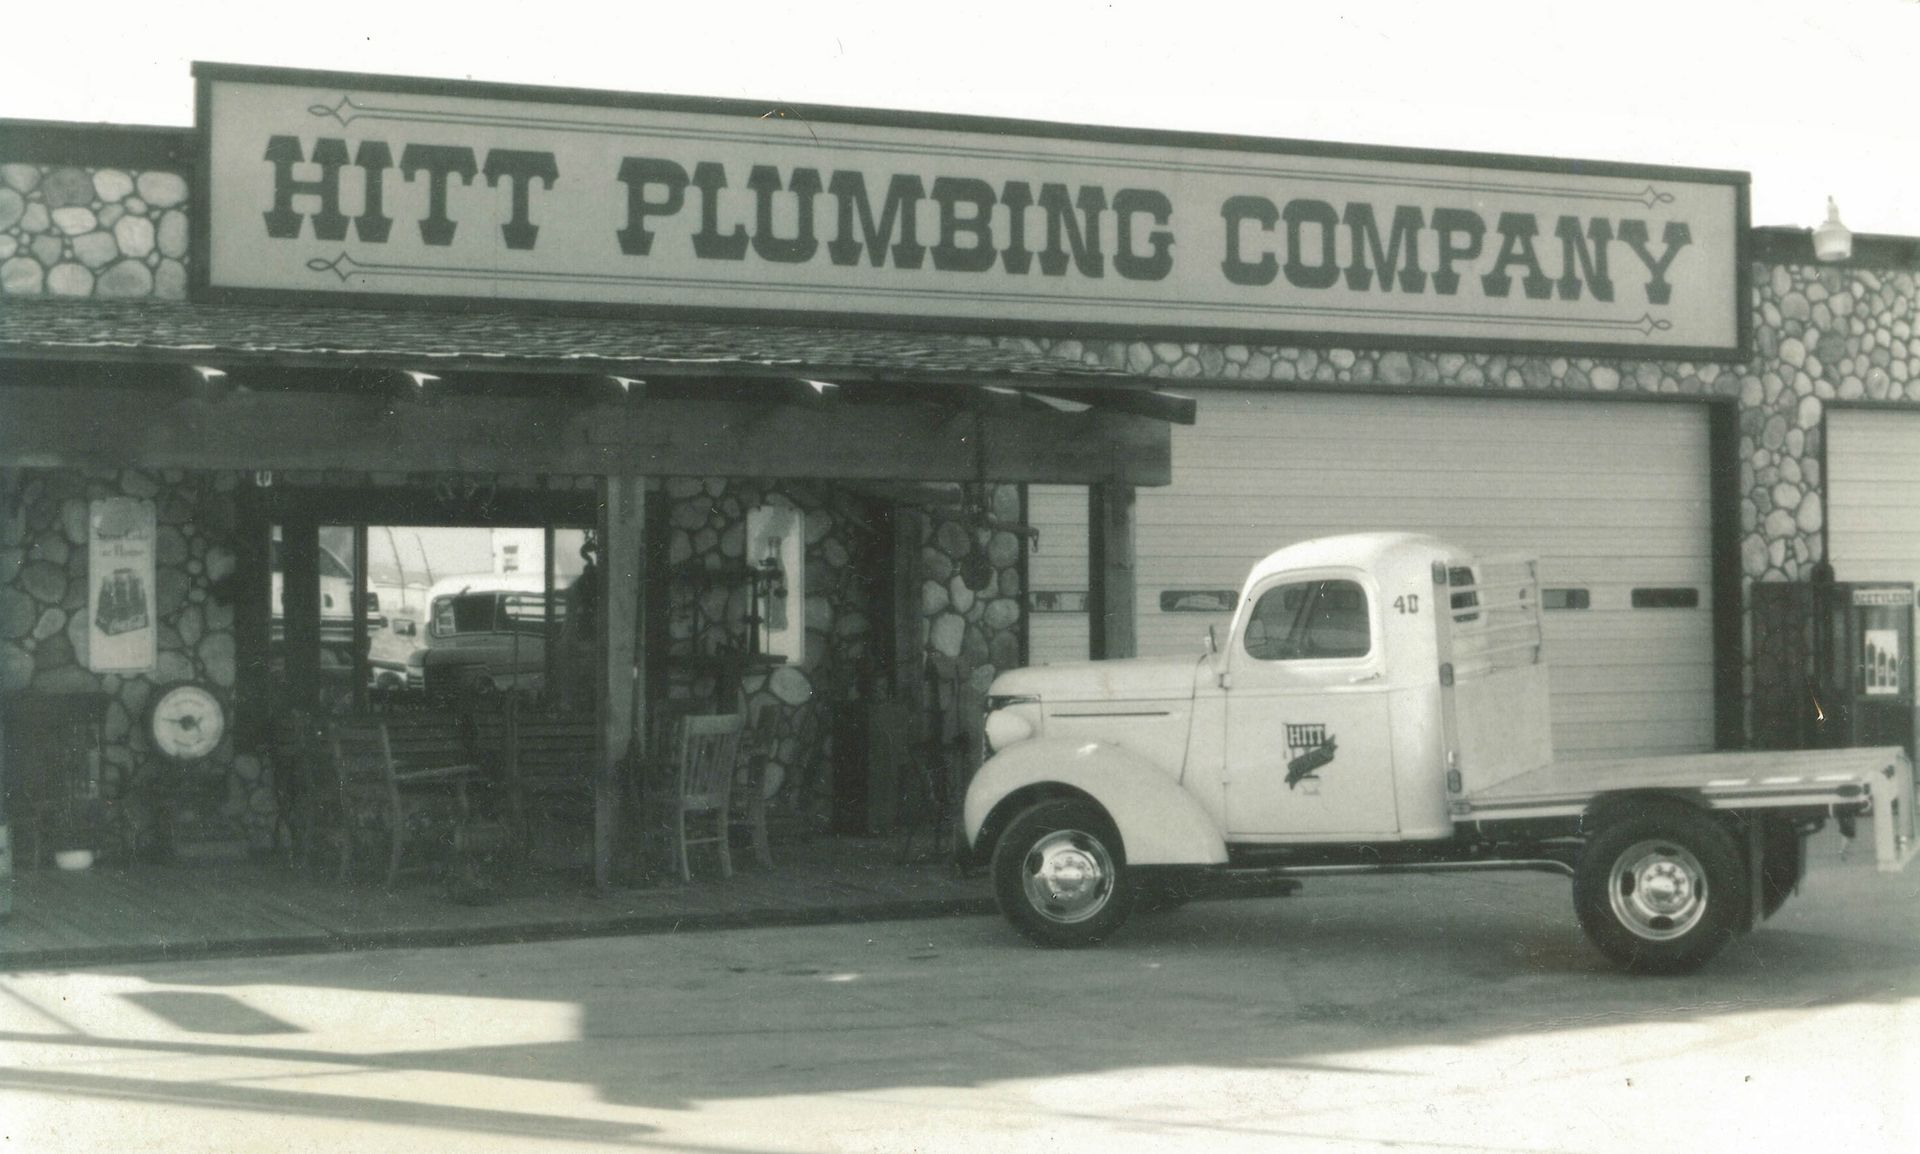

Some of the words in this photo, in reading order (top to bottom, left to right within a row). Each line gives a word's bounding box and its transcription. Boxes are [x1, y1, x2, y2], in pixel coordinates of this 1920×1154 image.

[262, 135, 560, 249] HITT
[615, 156, 1176, 282] PLUMBING
[1220, 195, 1693, 305] COMPANY
[1393, 594, 1419, 614] 40
[1288, 726, 1324, 746] HITT
